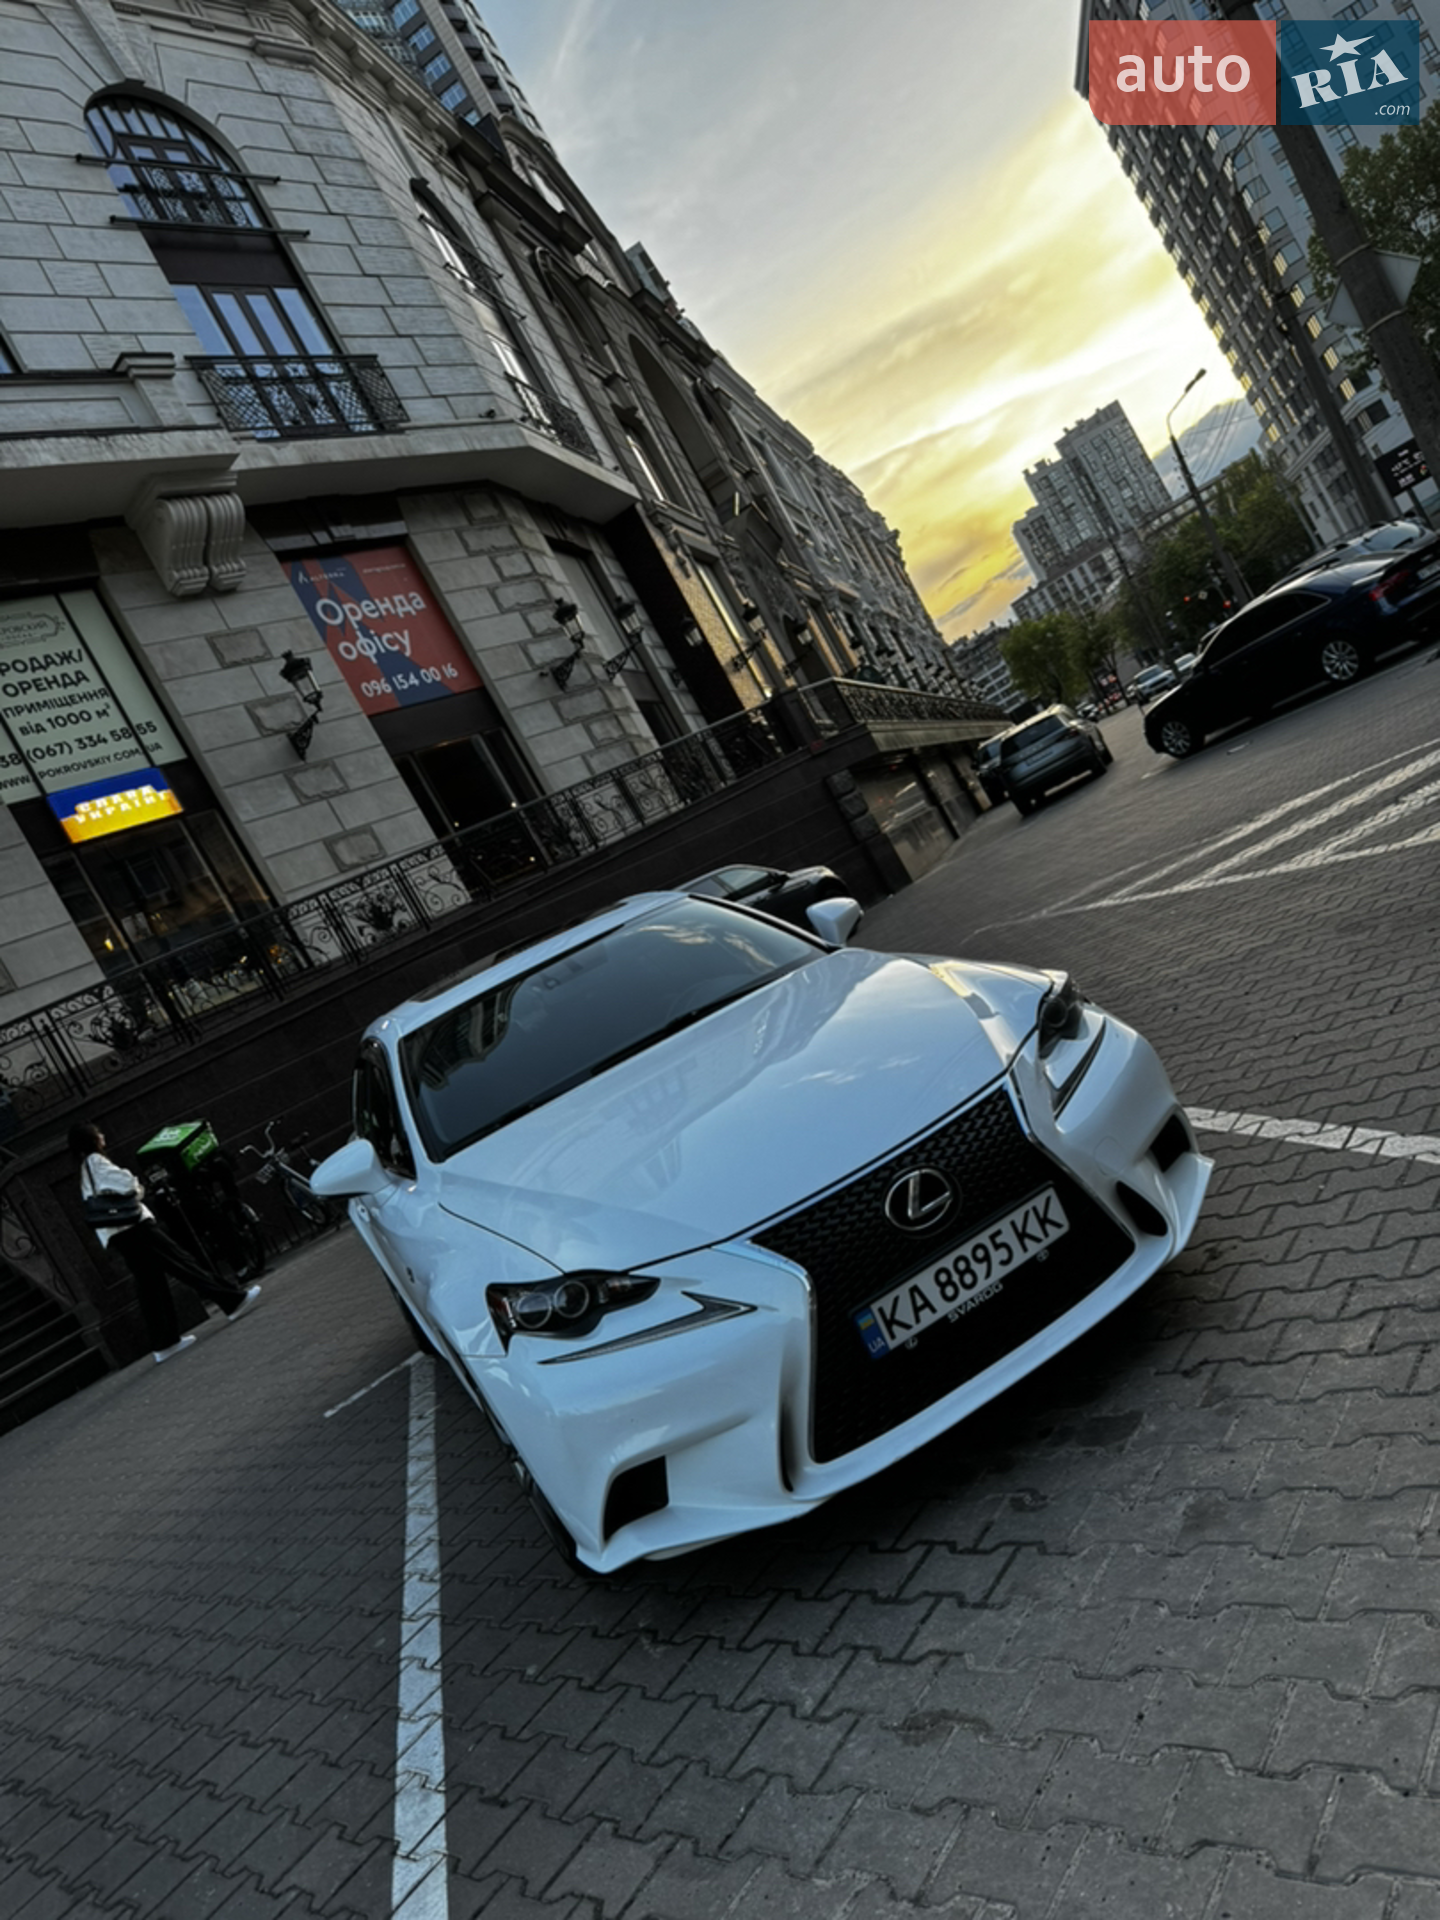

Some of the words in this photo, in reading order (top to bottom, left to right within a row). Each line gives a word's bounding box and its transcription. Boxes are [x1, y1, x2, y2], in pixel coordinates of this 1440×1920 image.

[316, 592, 426, 629] Оренда
[0, 648, 83, 677] РОДАЖ/
[338, 629, 411, 664] офісу
[2, 670, 90, 698] ОРЕНДА
[361, 678, 392, 698] 096
[392, 672, 420, 690] 154
[420, 666, 441, 683] 00
[441, 662, 458, 679] 16
[2, 687, 110, 719] ПРИМІЩЕННЯ
[19, 721, 47, 737] від
[46, 710, 92, 730] 1000
[26, 740, 73, 764] (067)
[74, 733, 108, 751] 334
[109, 727, 133, 742] 58
[136, 720, 157, 736] 55
[877, 1284, 938, 1341] KA
[933, 1229, 1014, 1303] 8895
[1010, 1195, 1065, 1253] KK
[868, 1336, 886, 1353] UA
